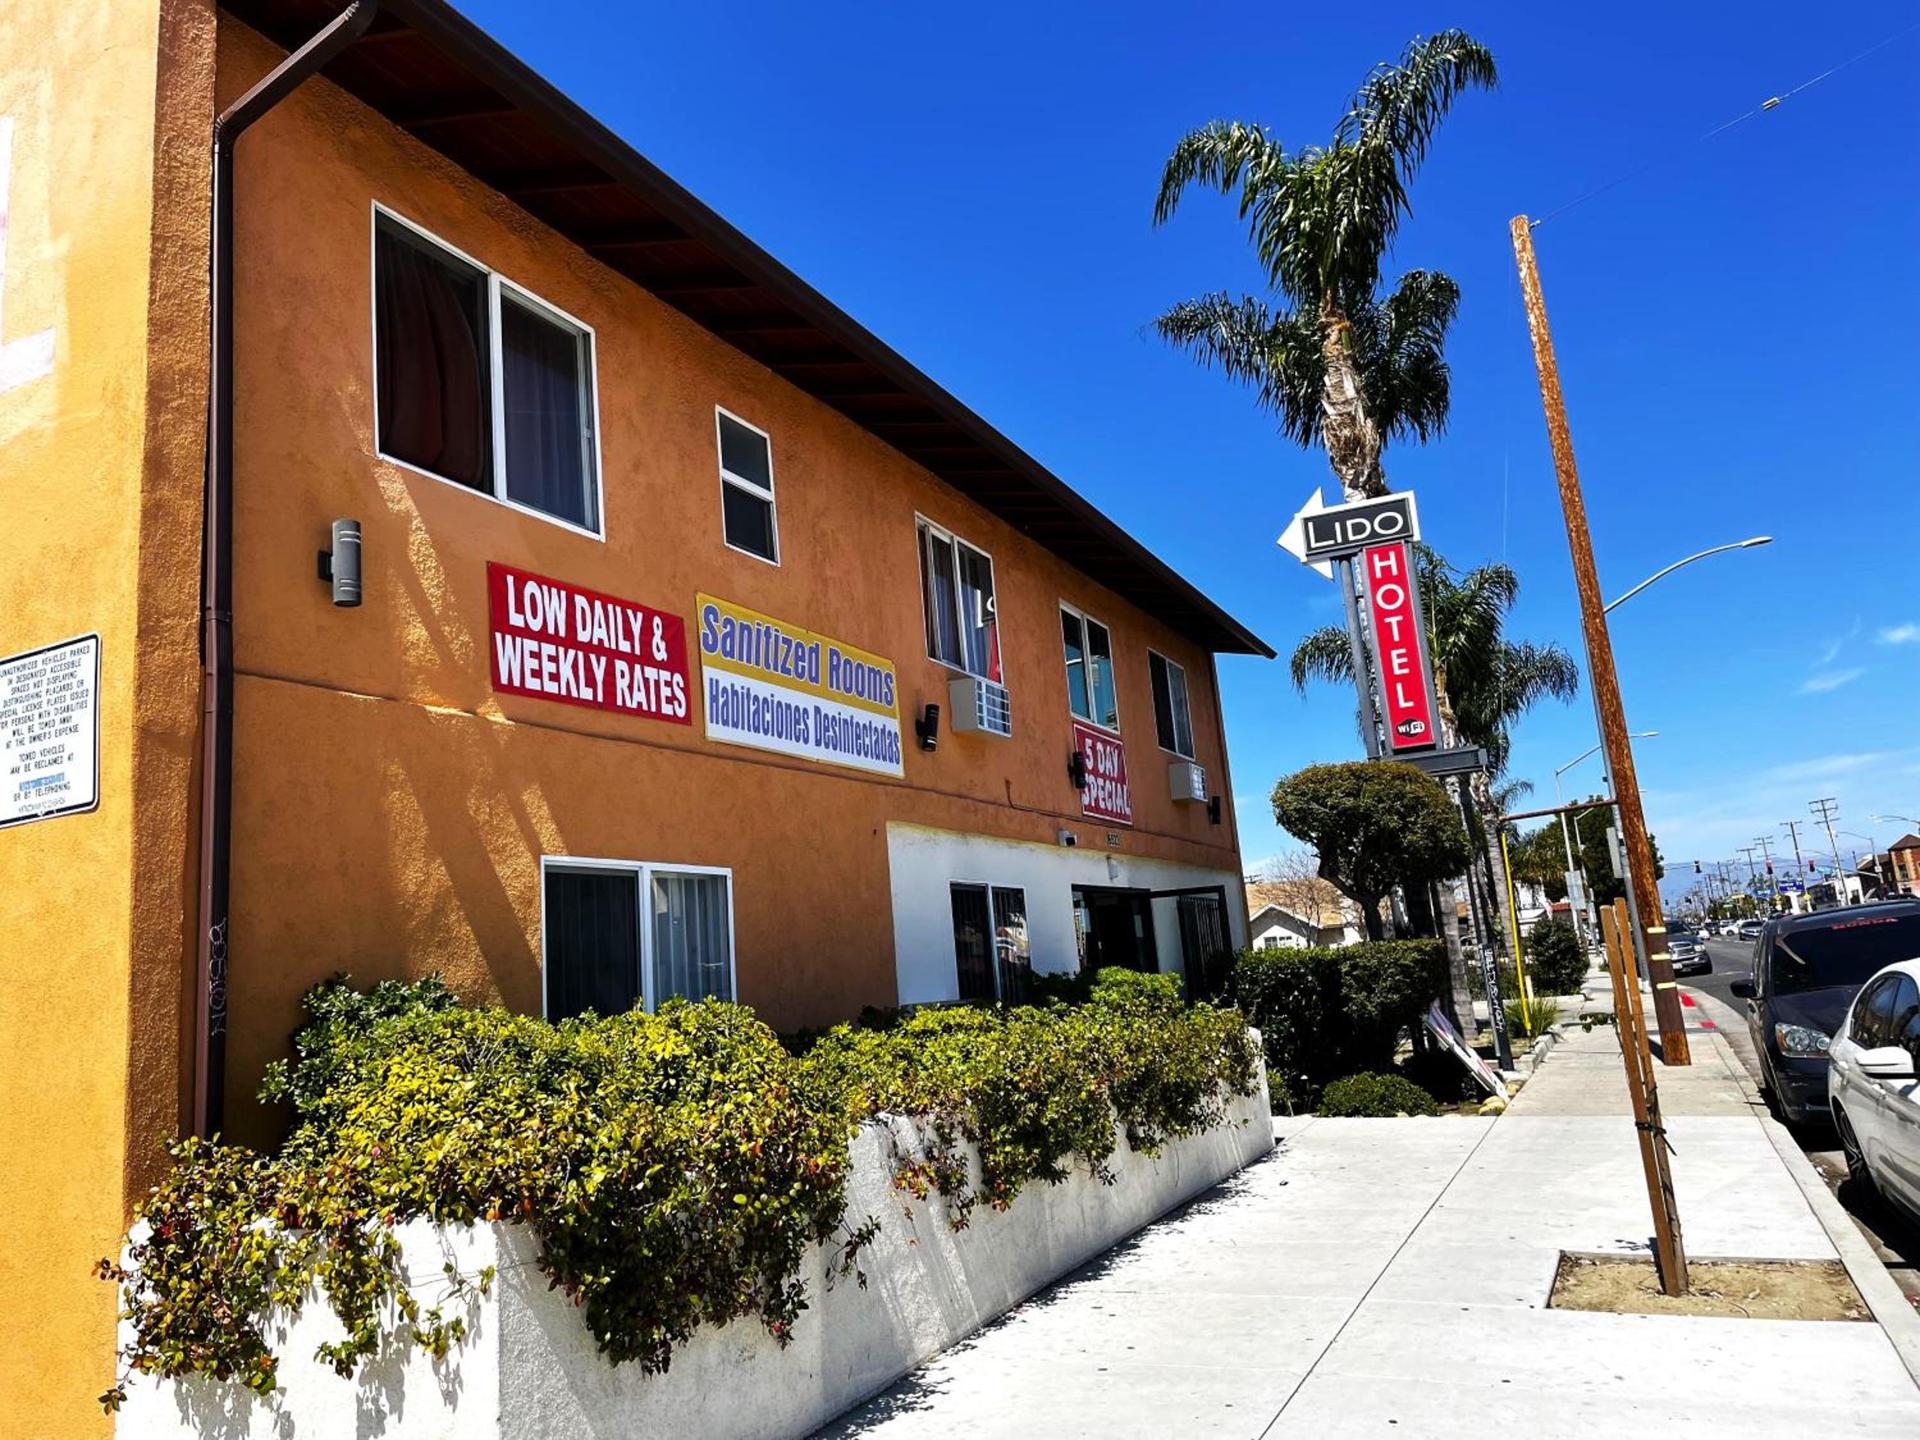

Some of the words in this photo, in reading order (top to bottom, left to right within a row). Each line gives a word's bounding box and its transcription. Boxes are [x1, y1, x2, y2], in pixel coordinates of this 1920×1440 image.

[1307, 511, 1404, 548] LIDO
[506, 574, 567, 638] LOW
[575, 594, 643, 656] DAILY
[651, 615, 668, 662] &
[701, 603, 822, 685] Sanitized
[828, 645, 895, 708] Rooms
[1373, 550, 1415, 709] HOTEL
[22, 700, 43, 713] LICENSE
[47, 694, 67, 706] PLATES
[494, 631, 607, 703] WEEKLY
[615, 659, 686, 718] RATES
[708, 676, 810, 745] Habitaciones
[814, 705, 901, 766] Desinfectadas
[1085, 738, 1094, 770] 5
[1096, 741, 1119, 778] DAY
[1081, 772, 1131, 815] SPECIAL
